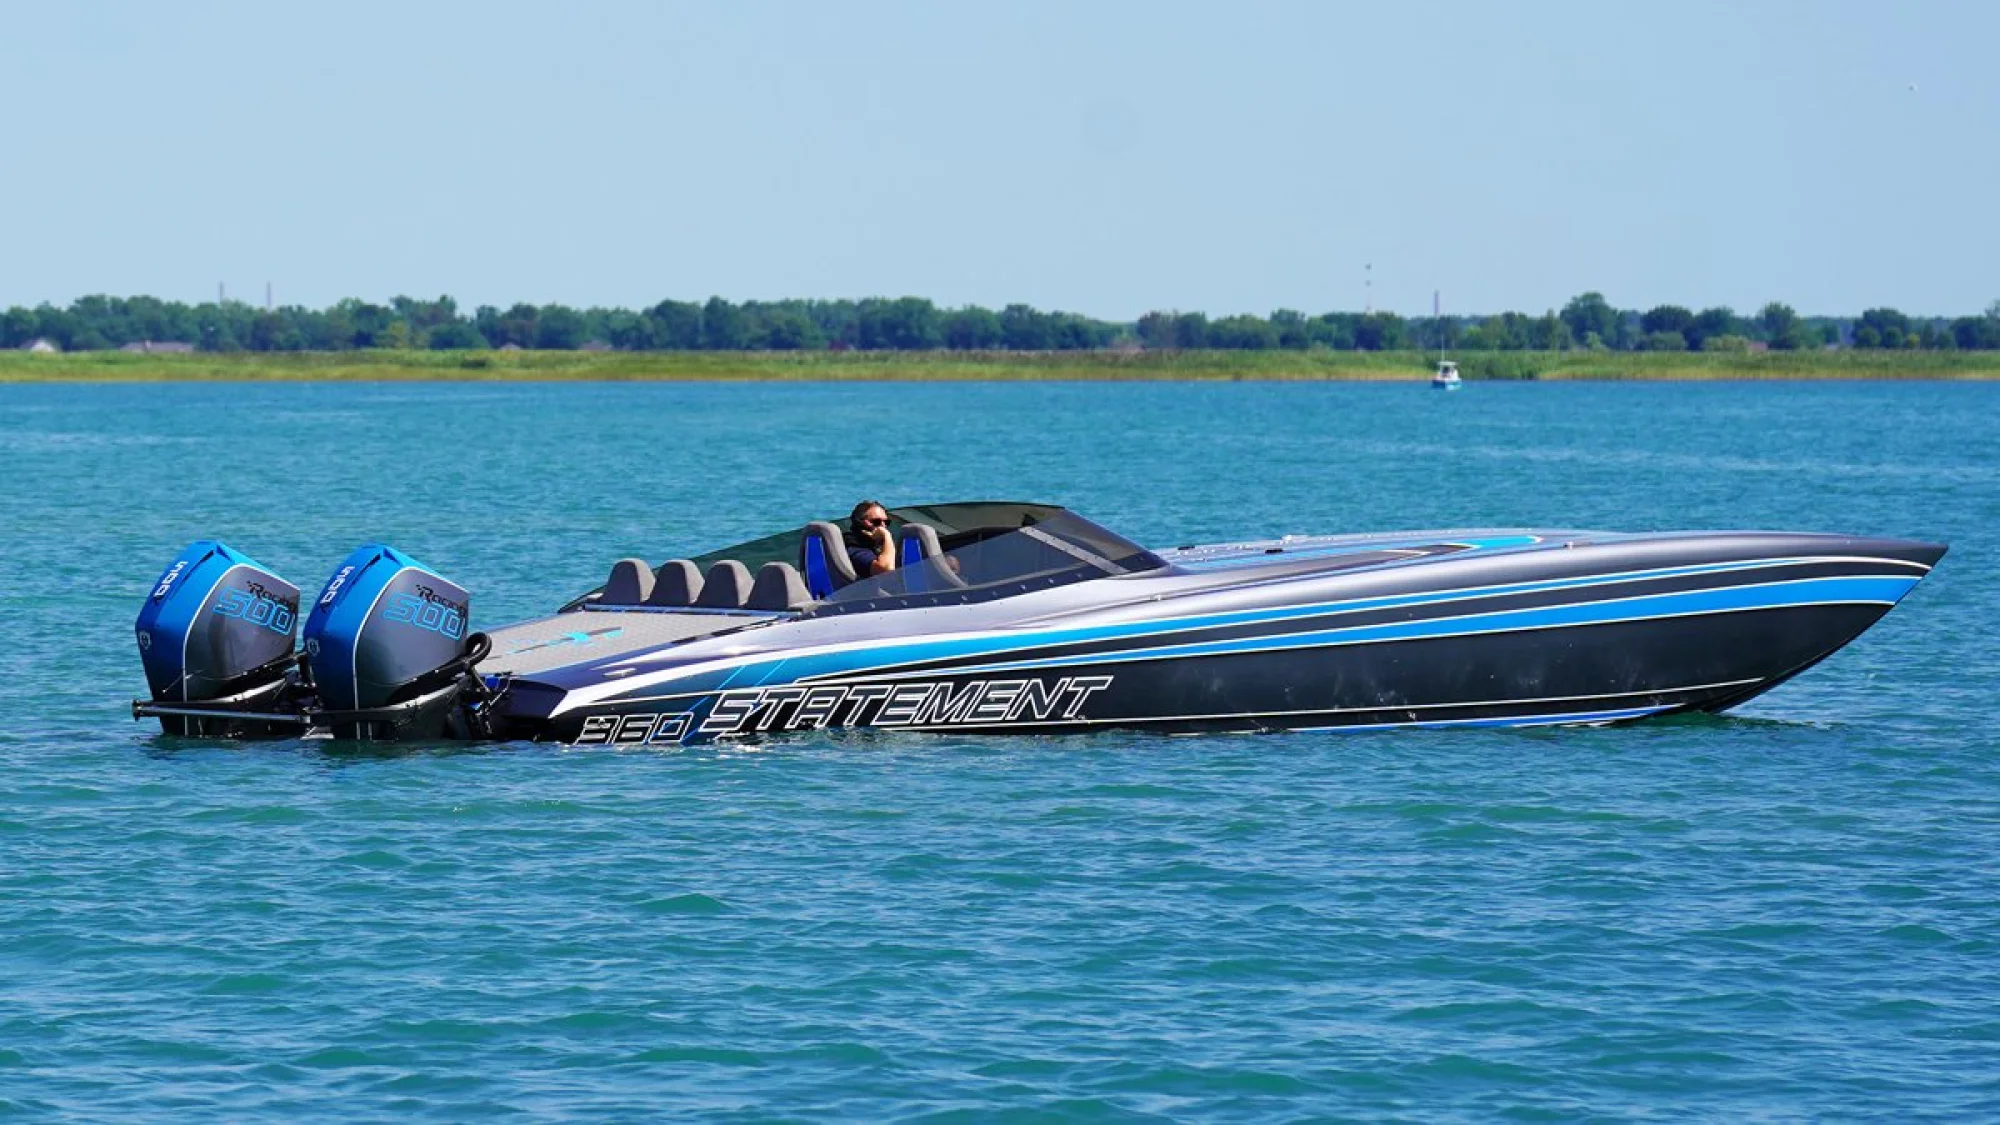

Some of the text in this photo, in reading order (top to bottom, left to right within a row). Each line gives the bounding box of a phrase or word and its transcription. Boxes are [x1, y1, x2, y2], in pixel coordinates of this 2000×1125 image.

[154, 561, 188, 597] 500
[320, 566, 355, 604] 500
[212, 587, 296, 635] 500
[383, 591, 466, 640] 500
[573, 675, 1114, 745] 360 STATEMENT
